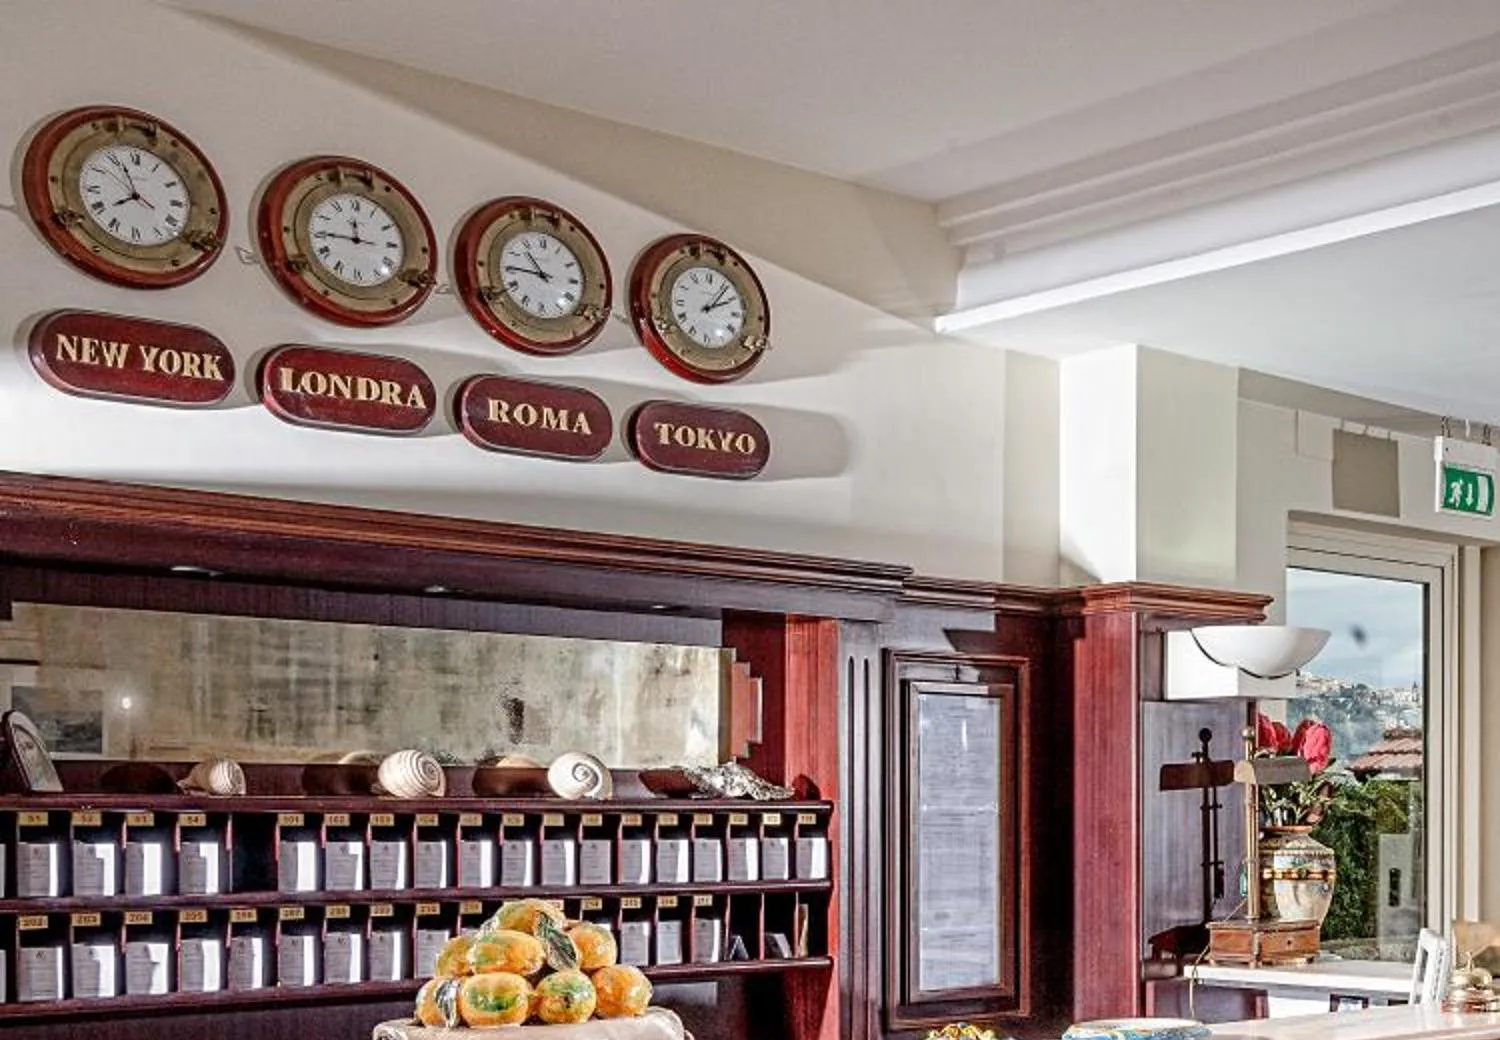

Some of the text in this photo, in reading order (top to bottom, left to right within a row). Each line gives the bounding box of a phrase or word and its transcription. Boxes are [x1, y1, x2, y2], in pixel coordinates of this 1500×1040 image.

[55, 332, 225, 382] NEW YORK
[279, 366, 427, 410] LONDRA
[487, 398, 593, 436] ROMA
[655, 422, 757, 456] TOKYO
